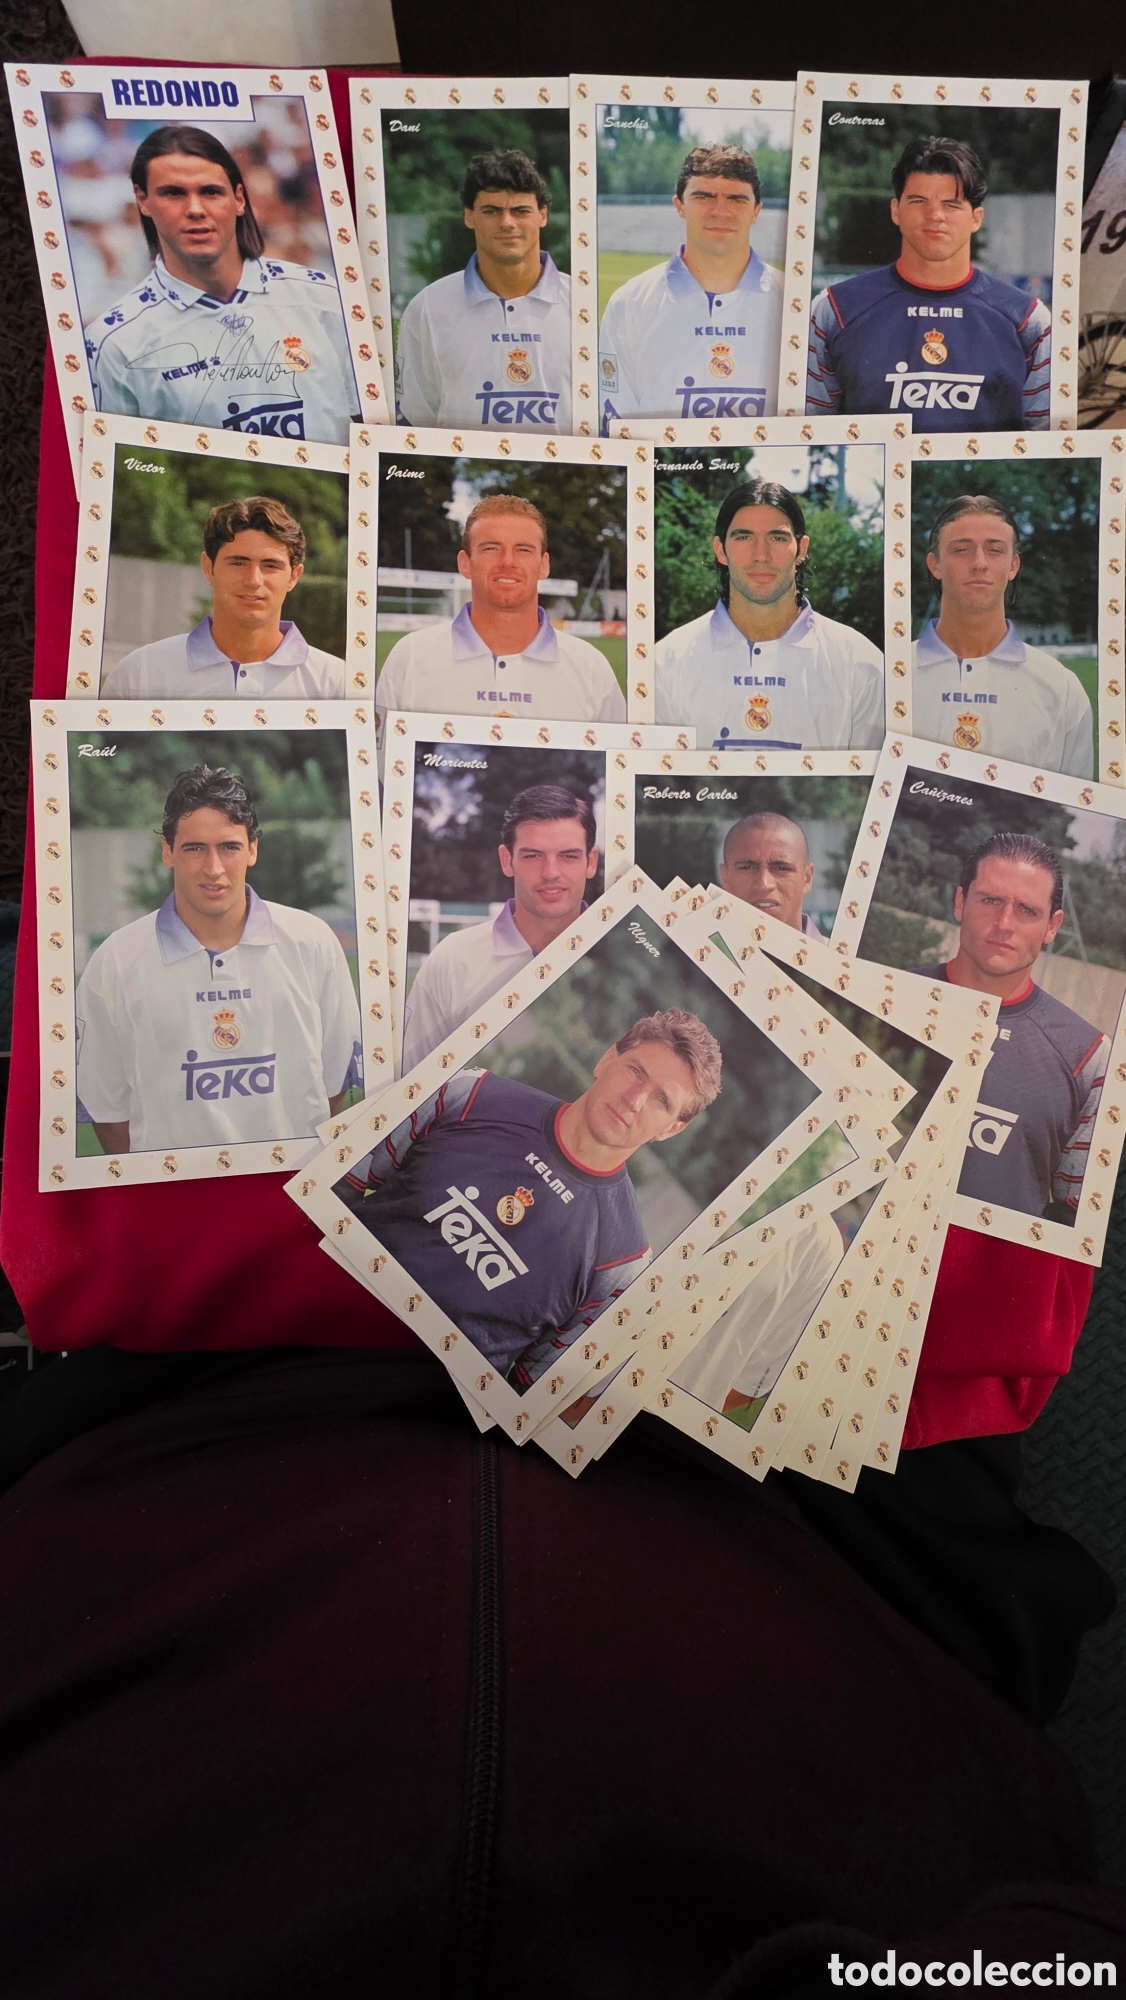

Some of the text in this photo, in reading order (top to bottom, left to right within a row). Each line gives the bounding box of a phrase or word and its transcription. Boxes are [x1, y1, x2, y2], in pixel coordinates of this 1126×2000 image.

[111, 79, 240, 107] REDONDO
[389, 119, 421, 132] Dani
[603, 116, 649, 130] Sanchis
[828, 112, 886, 126] Contreras
[907, 306, 963, 318] KELME
[491, 333, 542, 343] KELME
[694, 326, 746, 336] KELME
[161, 359, 209, 382] KELME
[385, 465, 425, 480] Jaime
[708, 458, 740, 473] Sanz
[733, 675, 787, 687] KELME
[476, 691, 532, 703] KELME
[941, 692, 998, 704] KELME
[77, 744, 117, 757] Raúl
[423, 753, 488, 769] Morientes
[643, 786, 739, 801] Roberto Carlos
[909, 781, 974, 806] Cañizares
[628, 922, 660, 957] Illgner
[196, 989, 252, 1002] KELME
[524, 1152, 575, 1204] KELME
